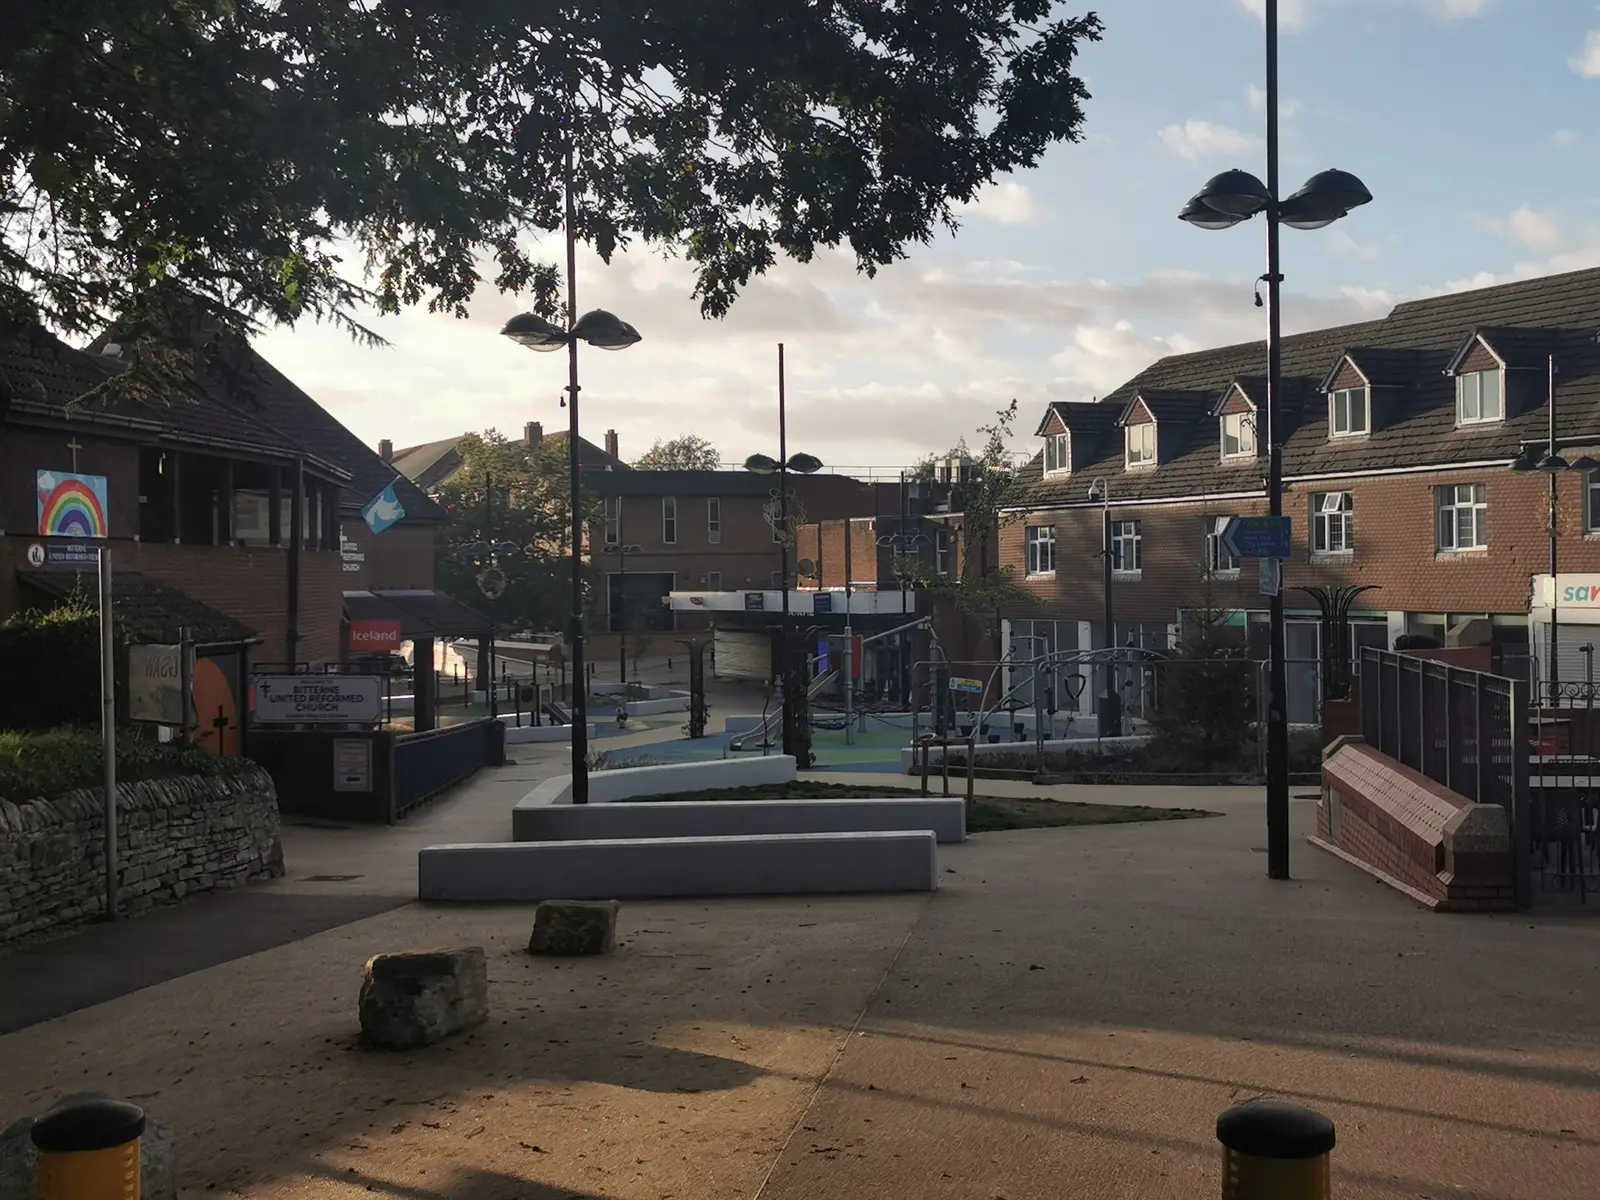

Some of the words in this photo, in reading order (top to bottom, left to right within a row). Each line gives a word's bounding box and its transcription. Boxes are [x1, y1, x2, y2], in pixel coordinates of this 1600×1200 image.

[352, 630, 397, 641] Iceland
[293, 685, 340, 694] BITTERNE
[269, 694, 307, 703] UNITED
[308, 694, 365, 703] REFORMED
[295, 703, 339, 712] CHURCH
